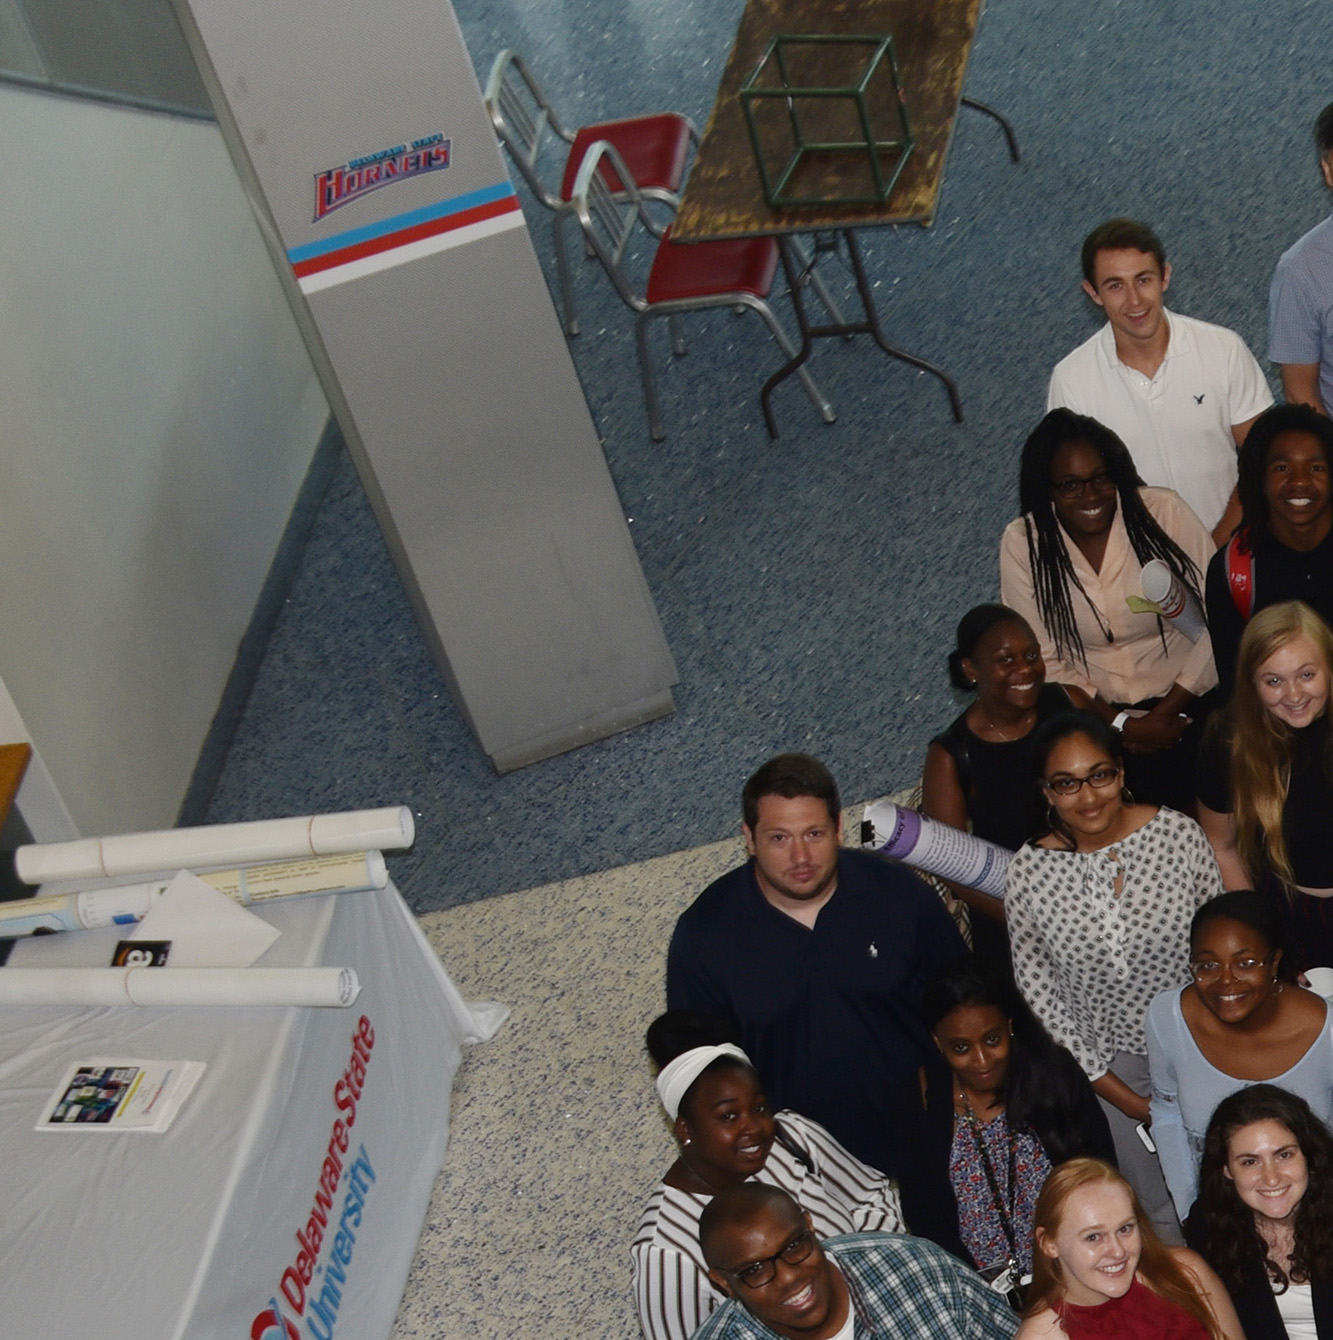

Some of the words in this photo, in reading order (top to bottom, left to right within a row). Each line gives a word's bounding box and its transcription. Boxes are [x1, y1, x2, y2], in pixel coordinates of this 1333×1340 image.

[314, 144, 450, 219] HORNETS
[280, 1118, 349, 1317] Delaware
[334, 1014, 375, 1129] State
